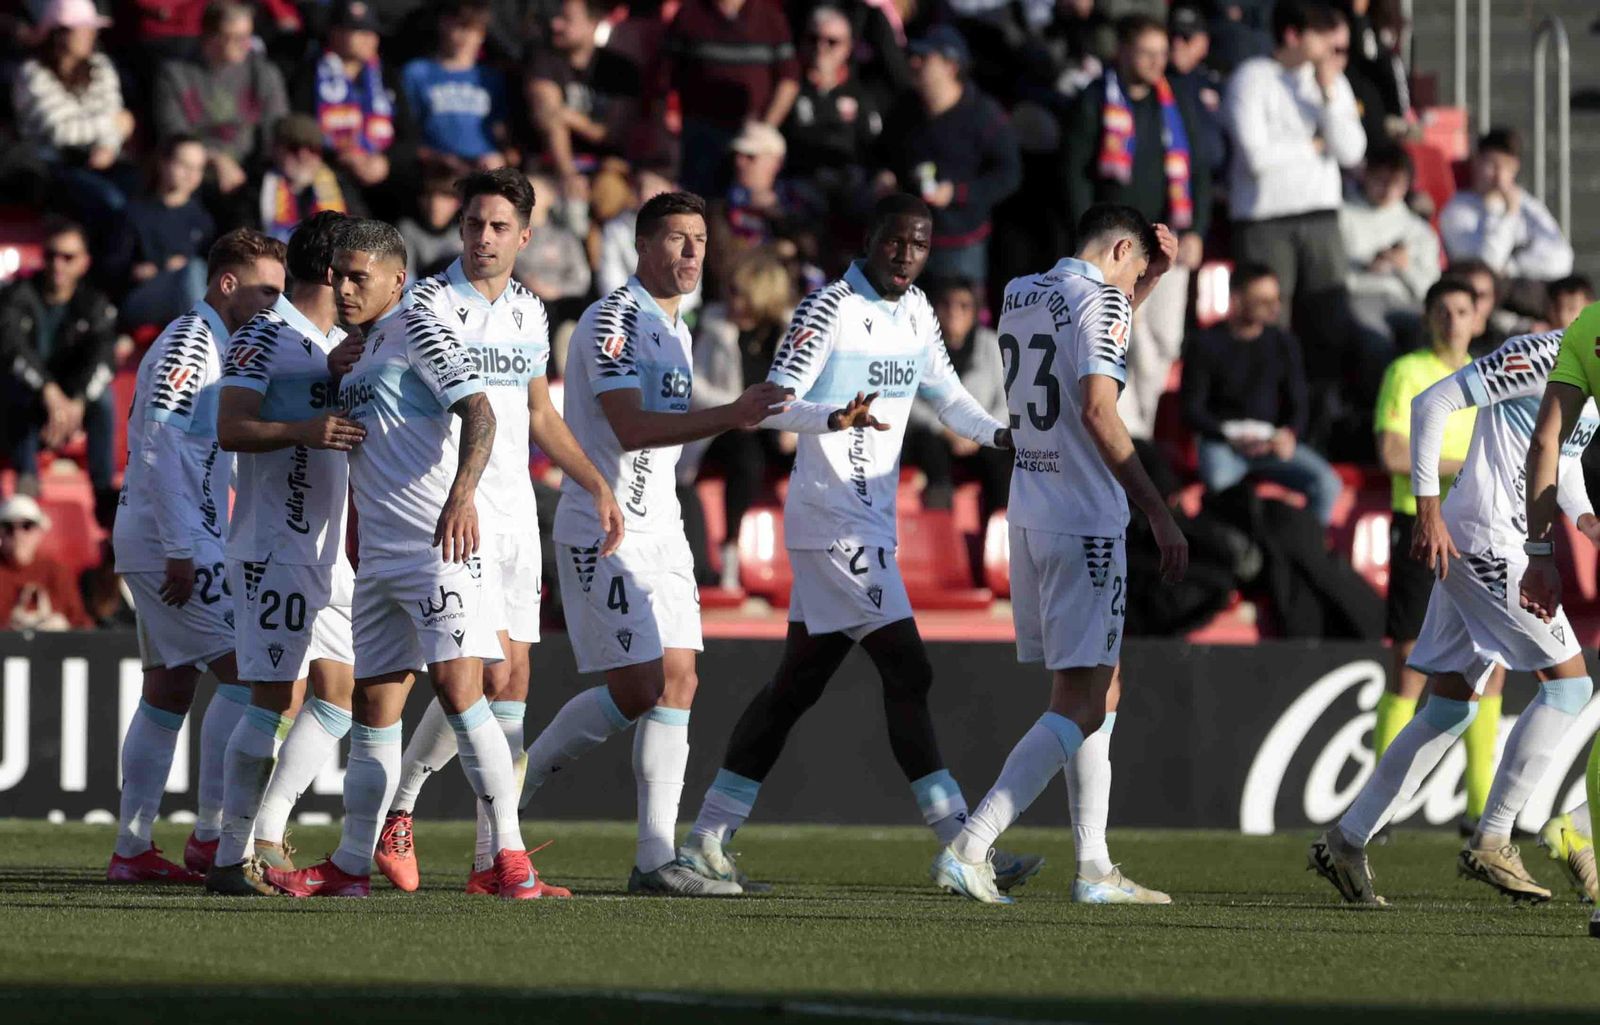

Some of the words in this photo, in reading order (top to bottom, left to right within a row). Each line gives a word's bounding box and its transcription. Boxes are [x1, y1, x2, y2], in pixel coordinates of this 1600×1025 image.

[998, 333, 1061, 432] 23
[260, 590, 306, 632] 20
[607, 576, 629, 615] 4
